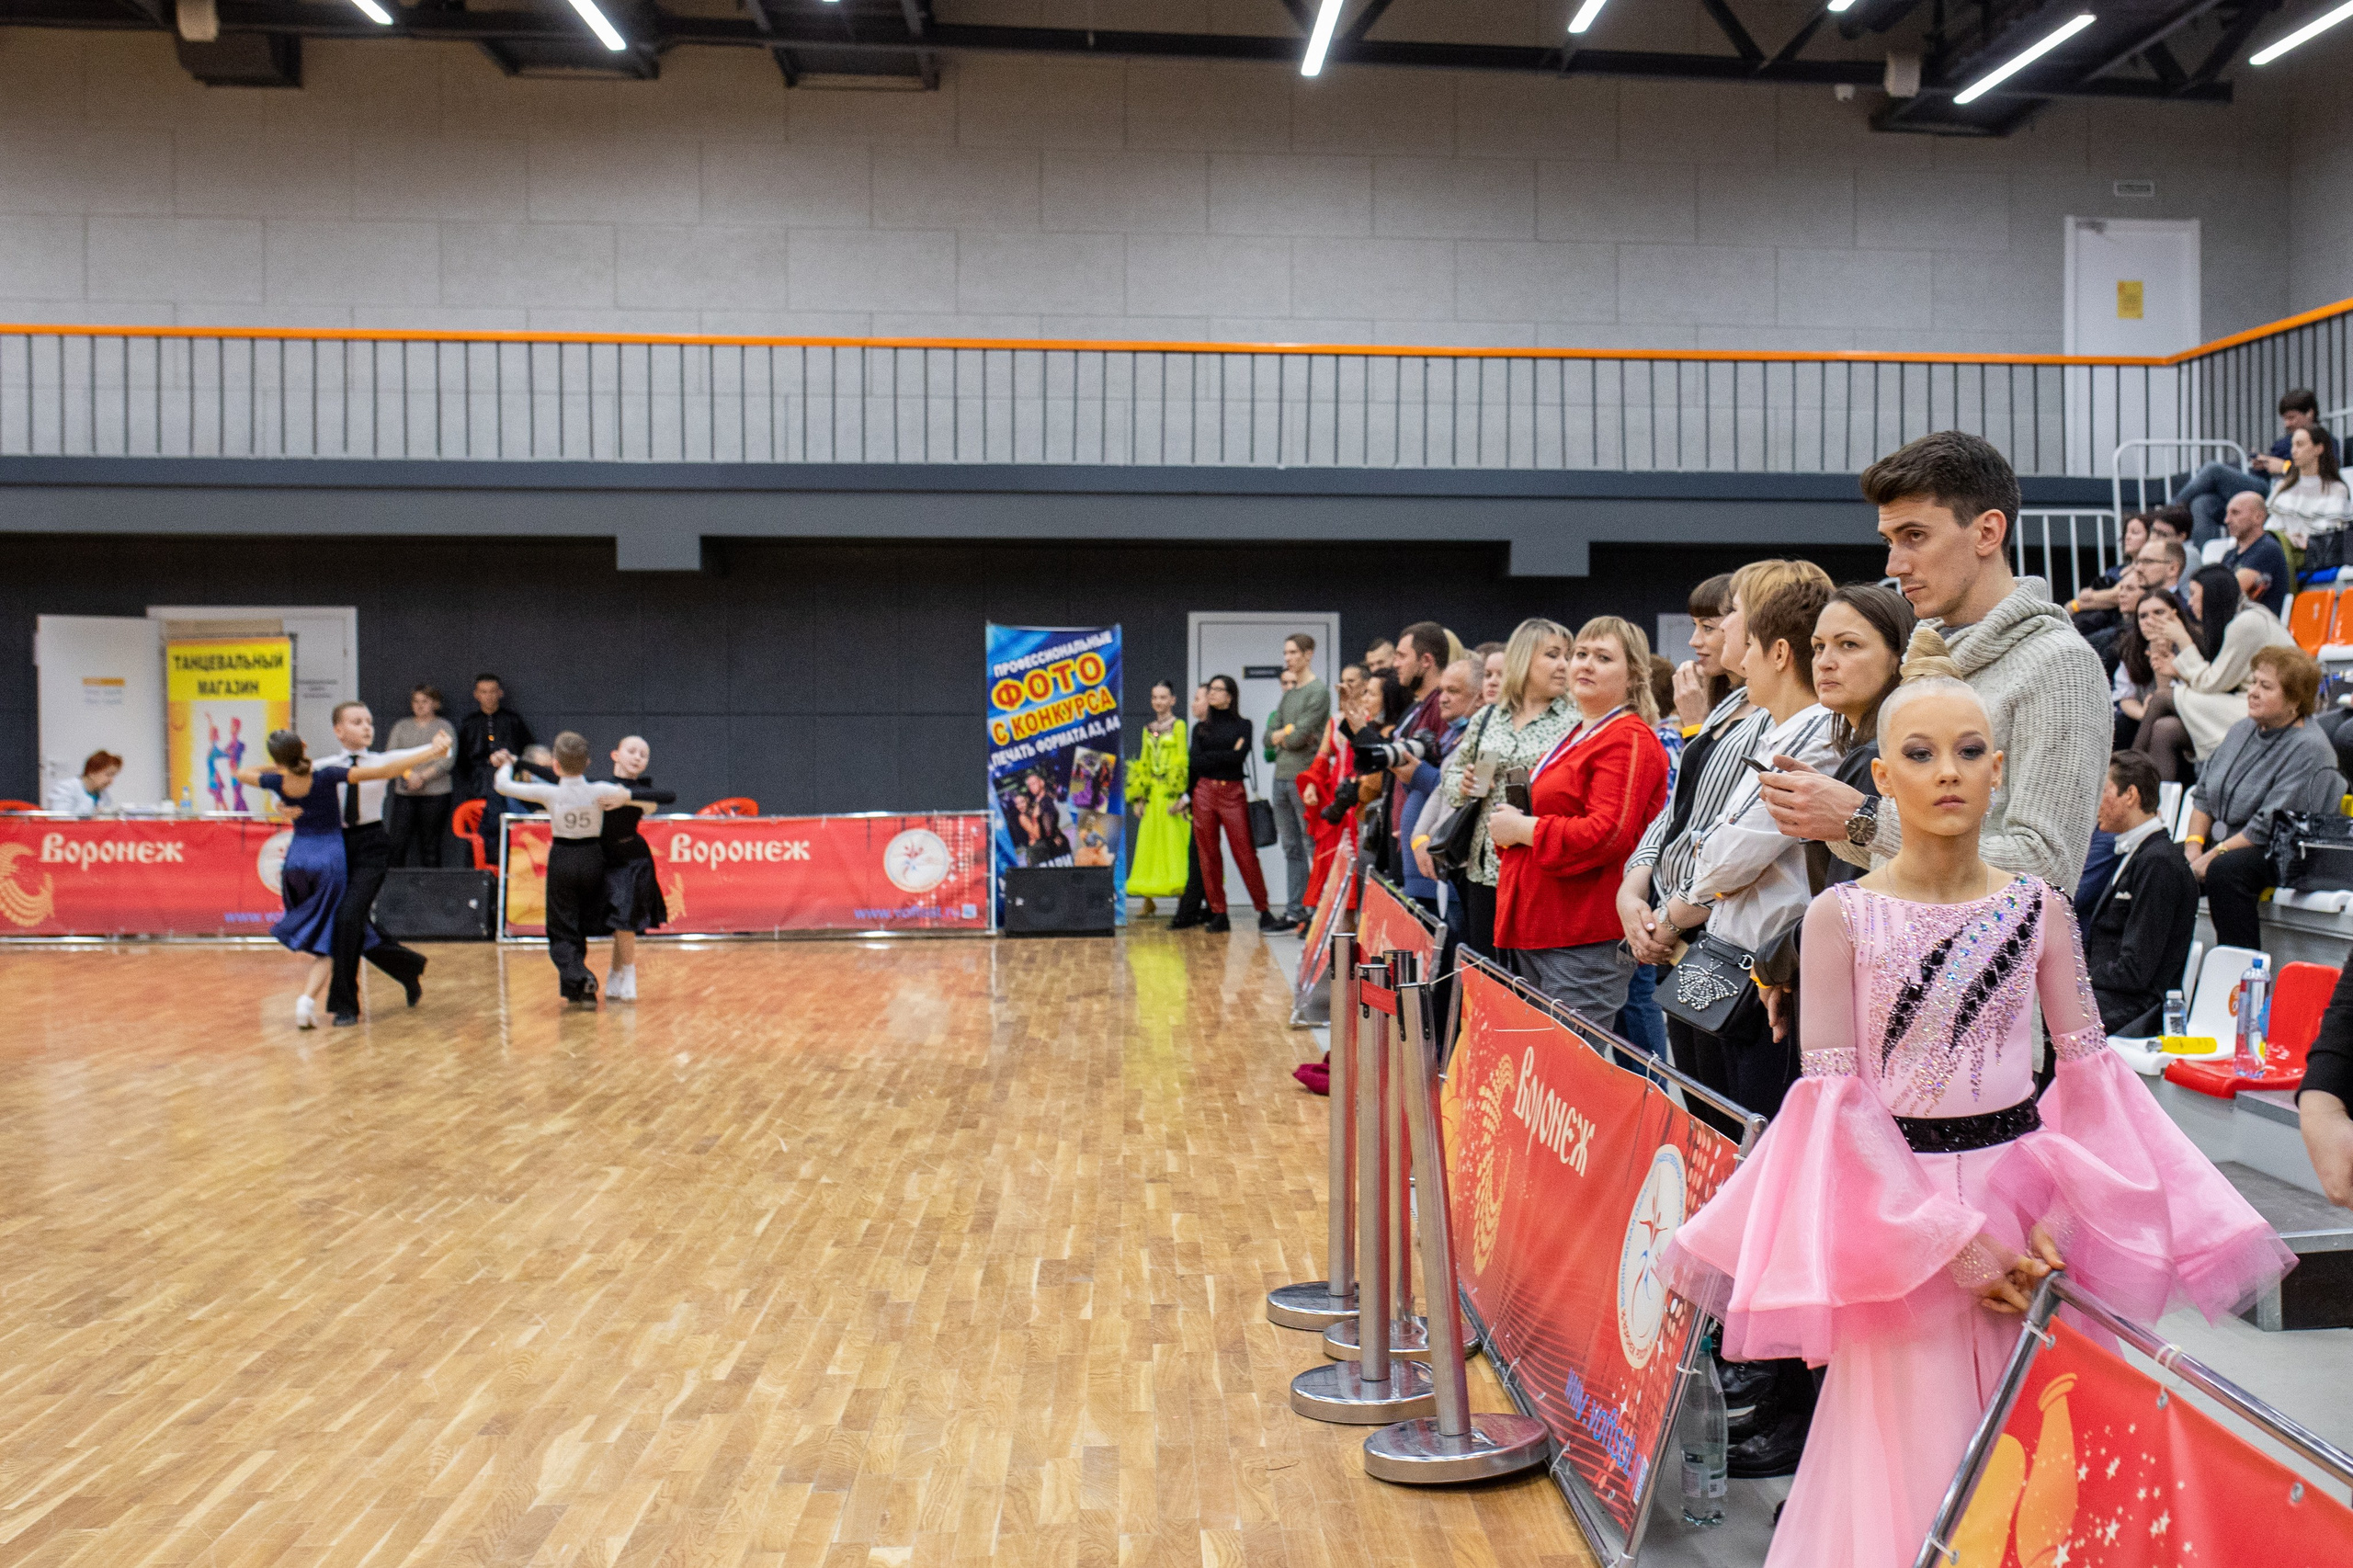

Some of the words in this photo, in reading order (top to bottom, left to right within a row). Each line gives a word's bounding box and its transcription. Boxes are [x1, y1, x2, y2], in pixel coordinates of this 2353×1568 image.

[174, 652, 284, 672] ТАНЦЕВАЛЬНЫЙ
[994, 631, 1112, 677] ПРОФЕССИОНАЛЬНЫЕ
[198, 679, 259, 696] МАГАЗИН
[992, 652, 1106, 711] ФОТО
[993, 721, 1011, 746] С
[1011, 687, 1117, 740] КОНКУРСА
[991, 742, 1037, 768] ПЕЧАТЬ
[1035, 725, 1088, 754] ФОРМАТА
[563, 812, 591, 829] 95
[40, 832, 184, 871] Воронеж
[668, 832, 811, 871] Воронеж
[1512, 1046, 1597, 1177] Воронеж
